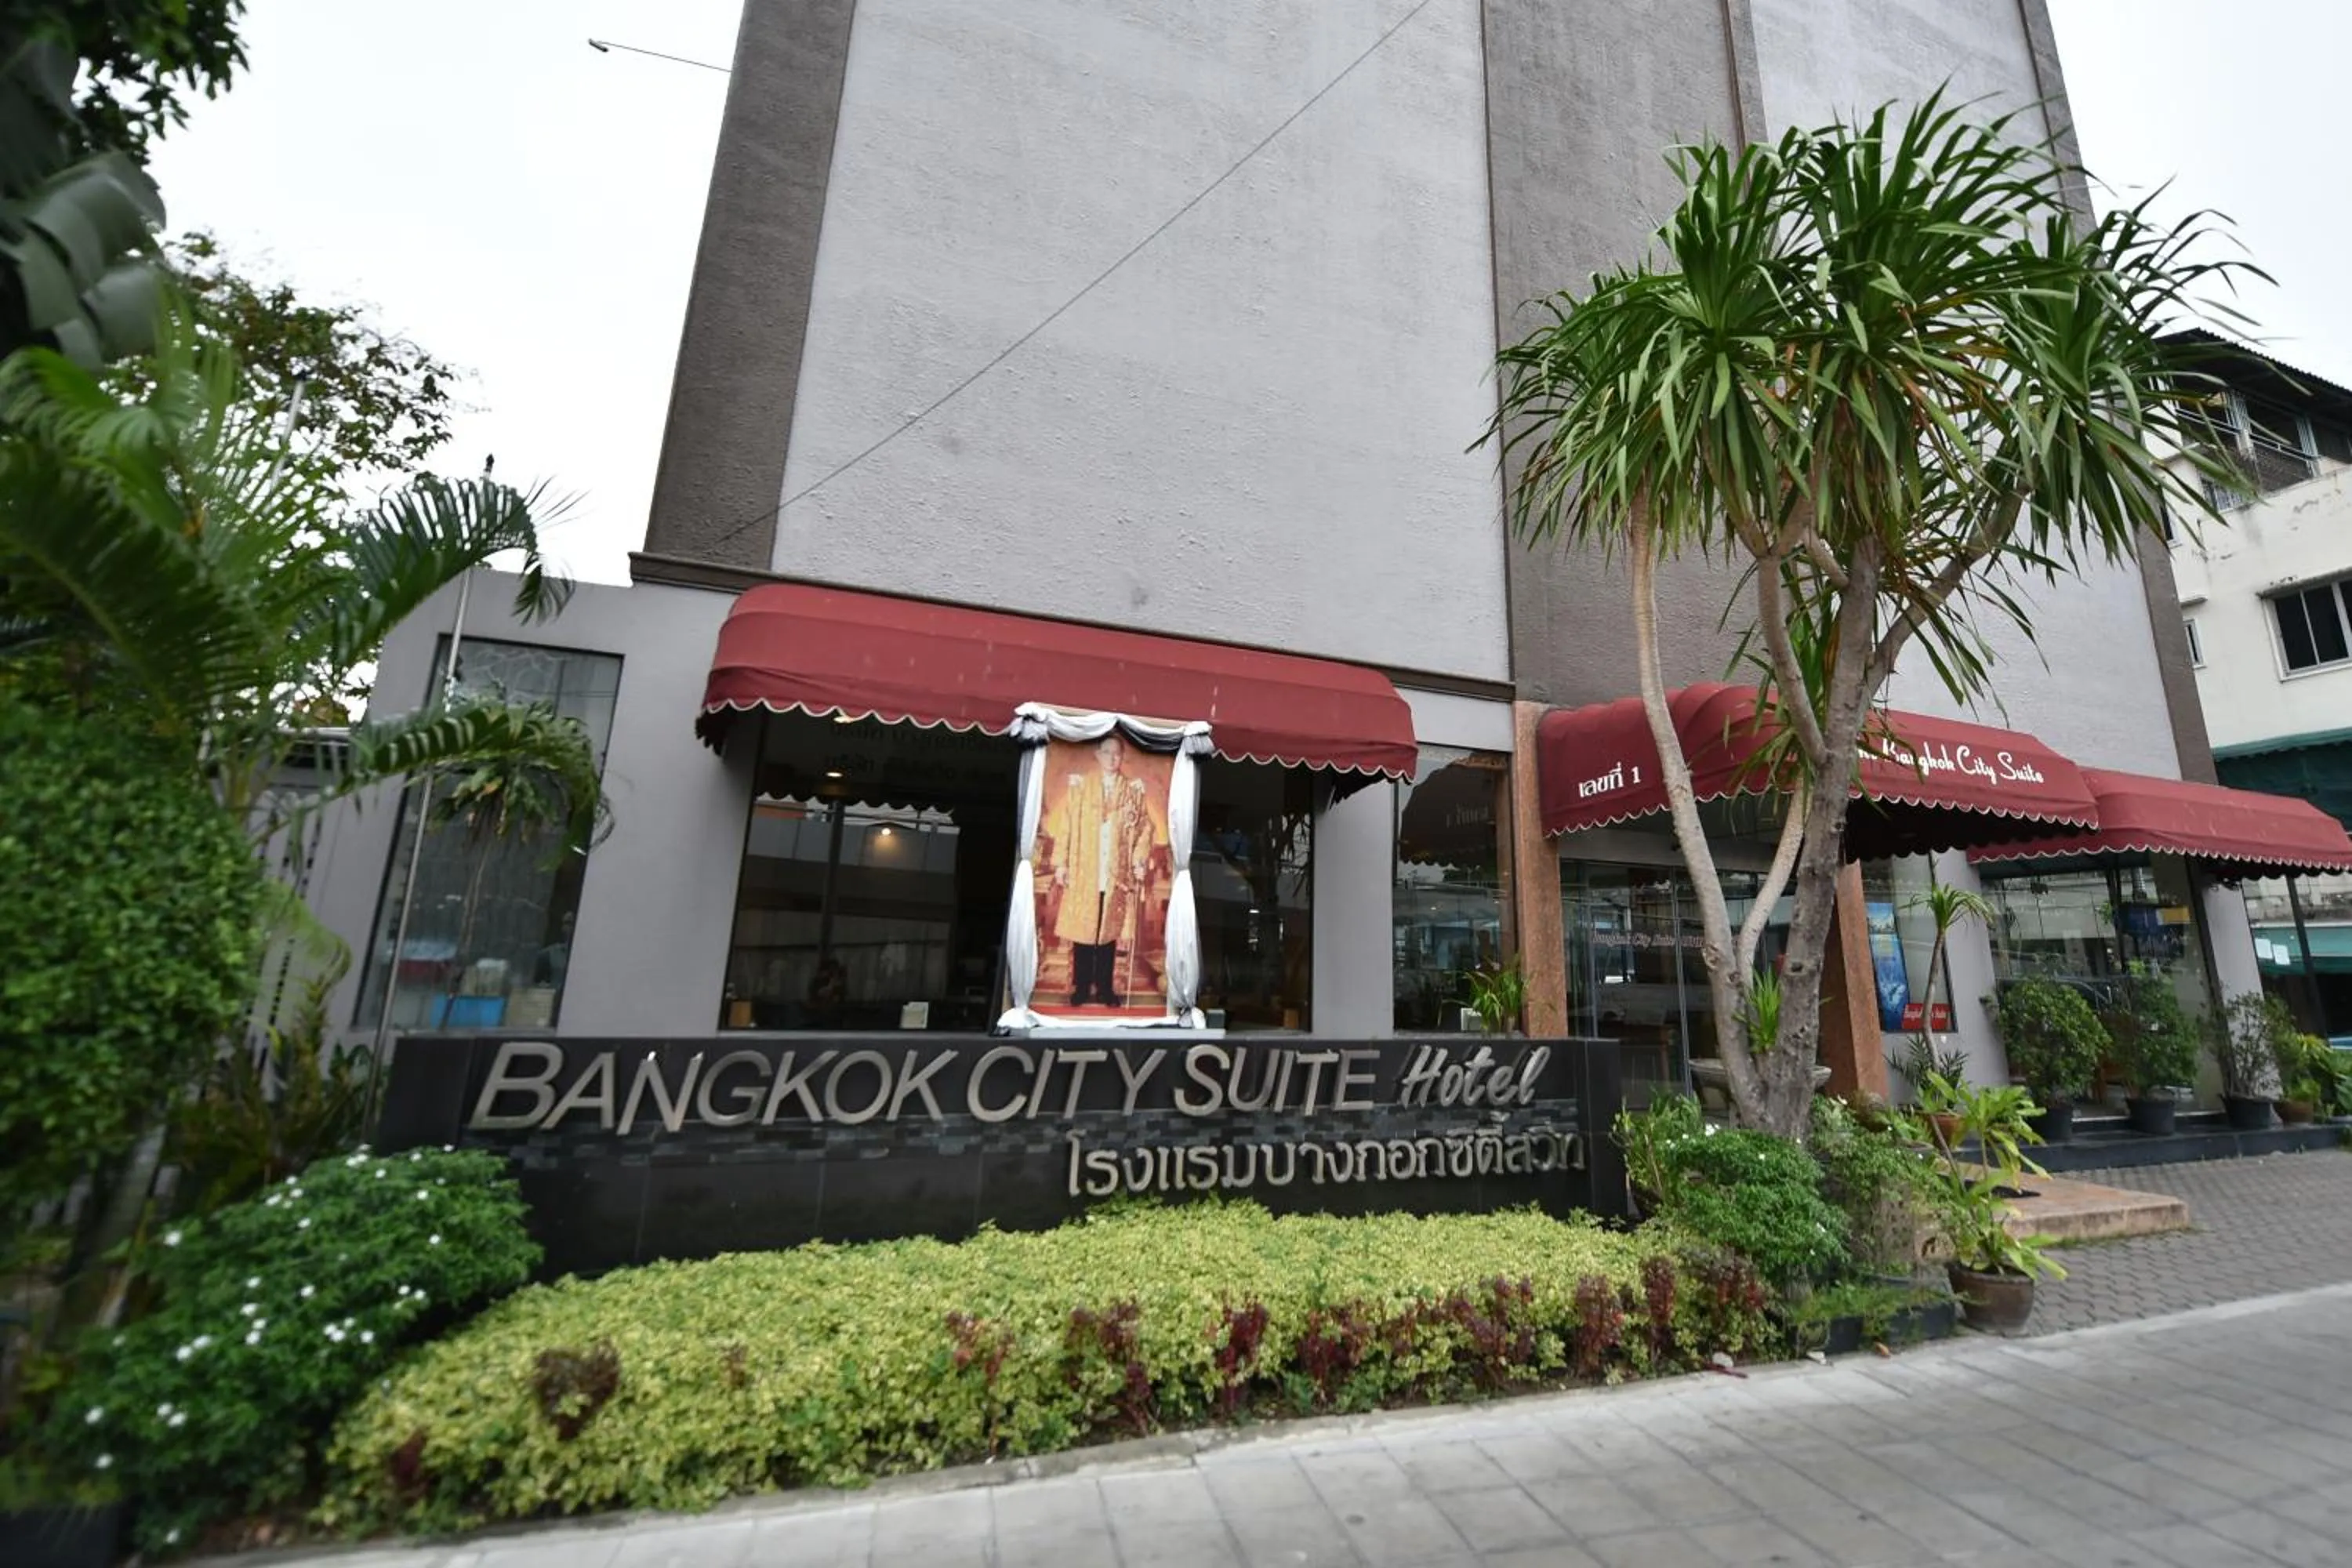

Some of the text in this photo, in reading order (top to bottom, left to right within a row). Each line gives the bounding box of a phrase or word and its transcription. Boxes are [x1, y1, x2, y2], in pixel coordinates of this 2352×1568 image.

[1578, 761, 1642, 797] เลขที่ 1
[1956, 745, 1997, 785] City
[1998, 752, 2044, 783] Suite
[469, 1041, 1551, 1135] BANGKOK CITY SUITE Hotel
